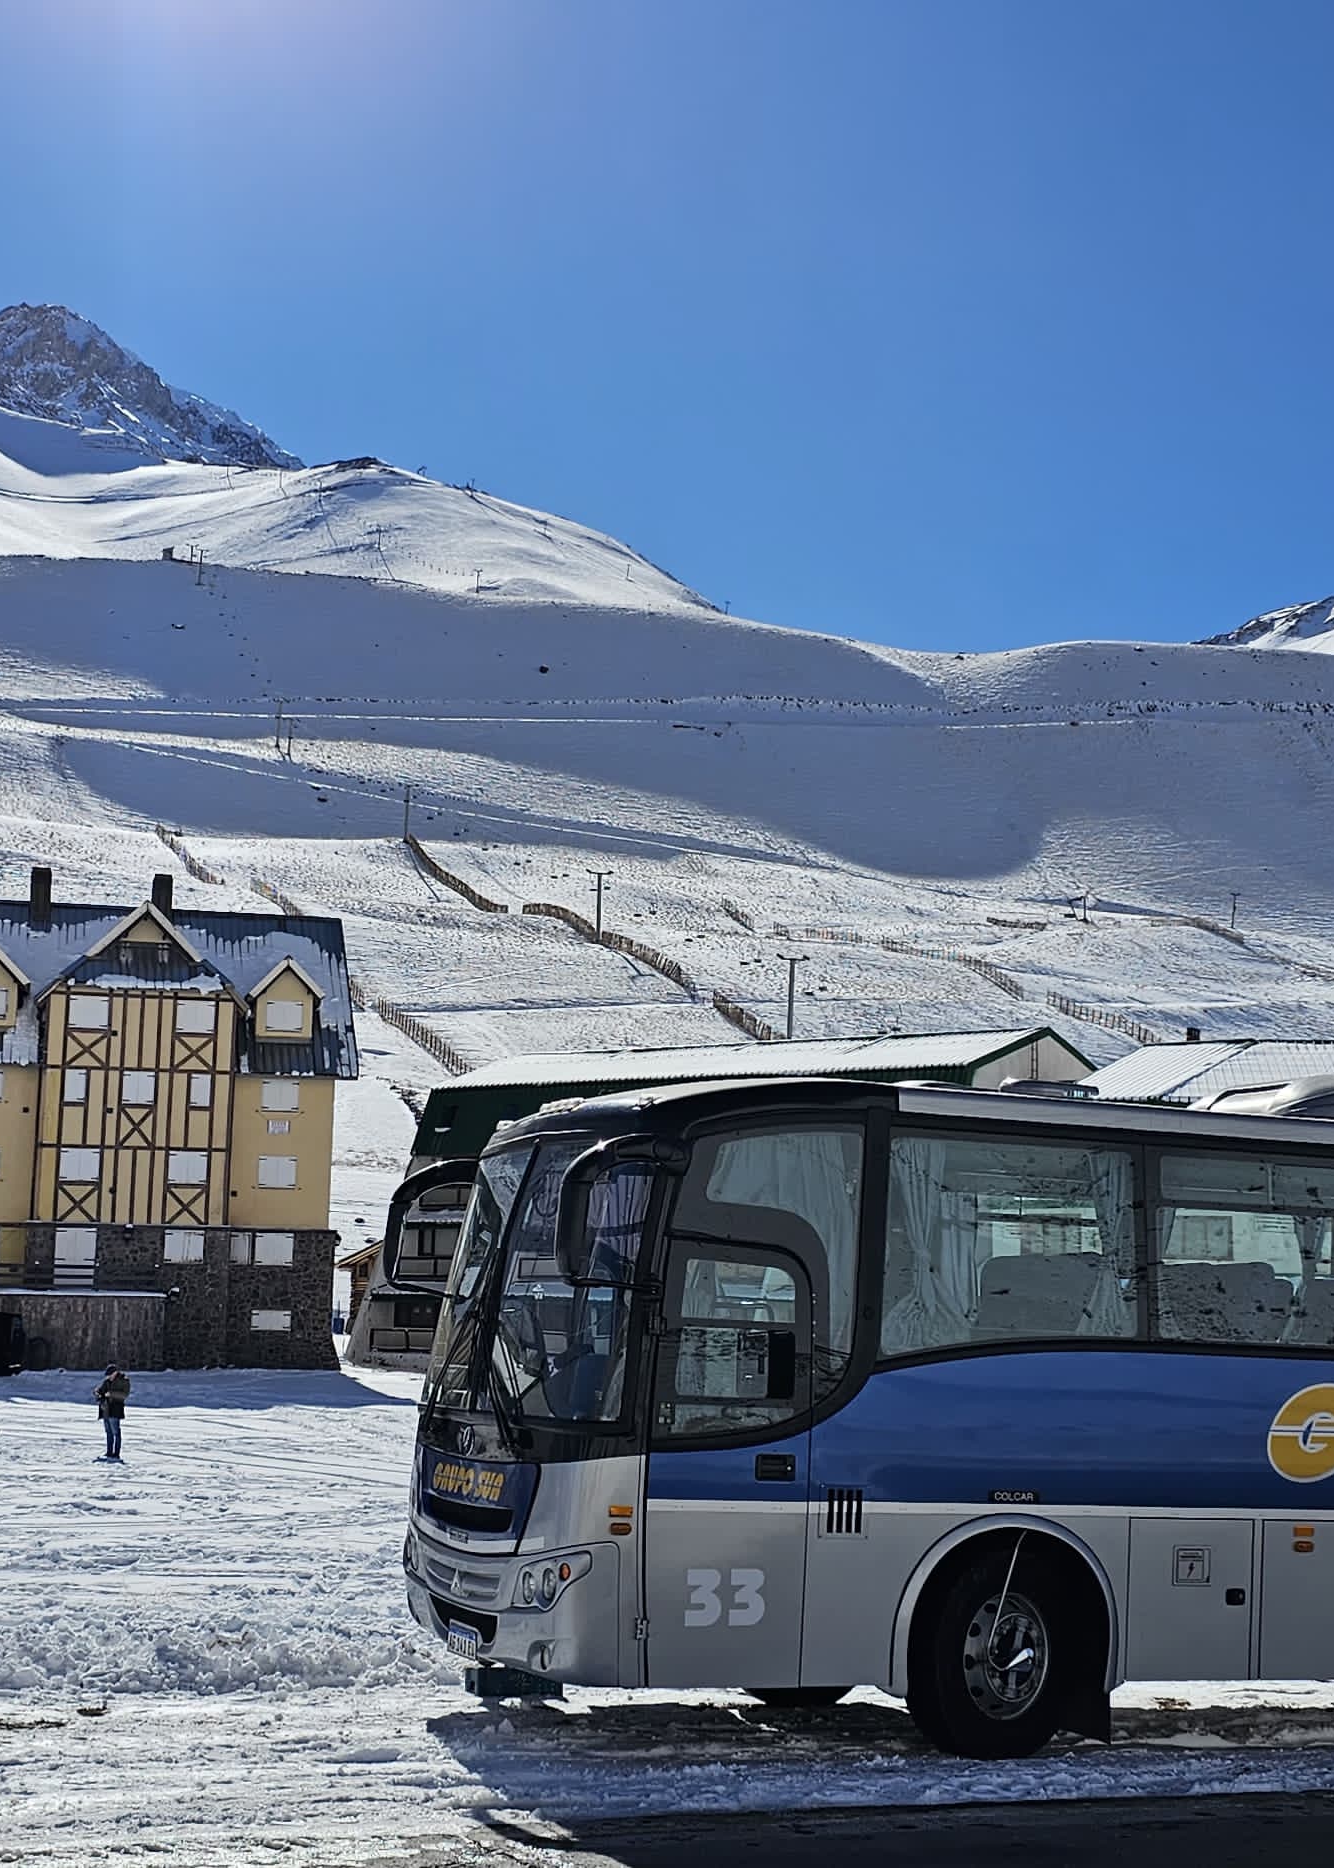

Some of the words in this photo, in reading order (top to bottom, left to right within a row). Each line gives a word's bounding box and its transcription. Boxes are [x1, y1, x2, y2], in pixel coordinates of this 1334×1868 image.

[432, 1462, 475, 1496] GRUPO
[474, 1471, 505, 1501] SUR
[994, 1491, 1034, 1502] COLCAR
[685, 1568, 765, 1626] 33
